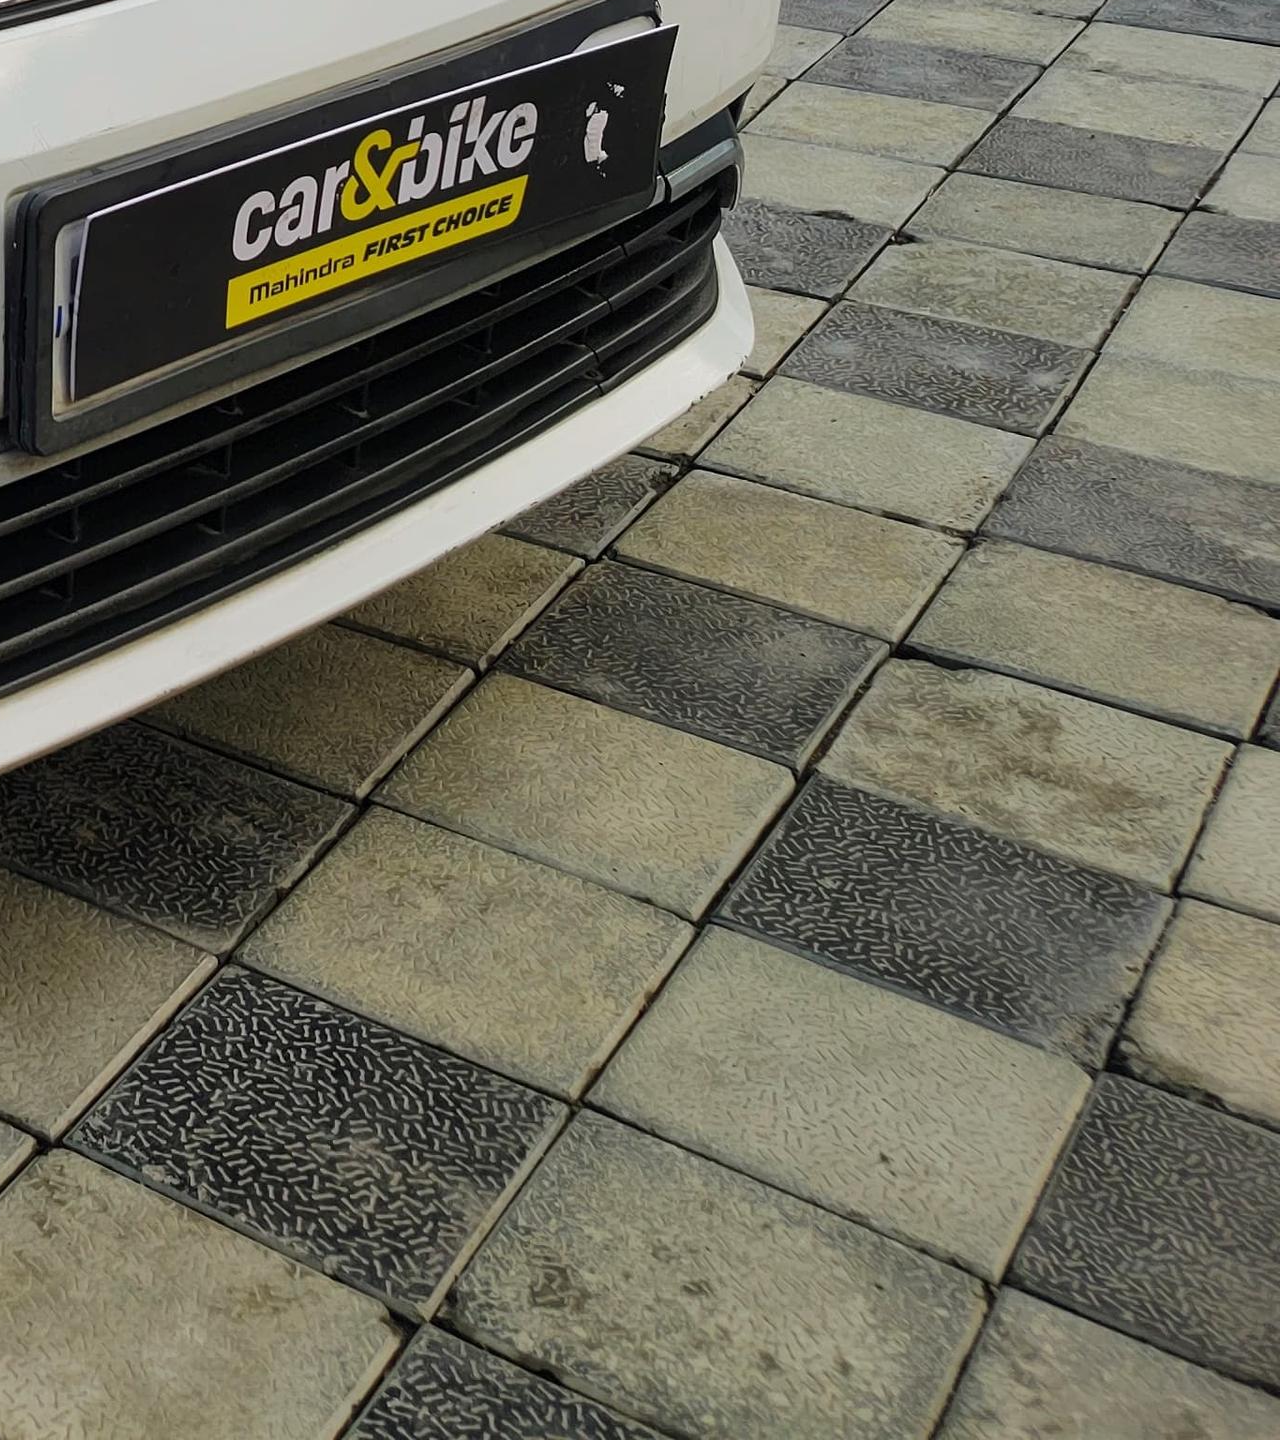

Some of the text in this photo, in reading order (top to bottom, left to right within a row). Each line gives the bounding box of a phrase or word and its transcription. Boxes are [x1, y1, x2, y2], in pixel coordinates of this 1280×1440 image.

[231, 95, 539, 262] car&bike
[248, 193, 514, 306] Mahindra FIRST CHOICE
